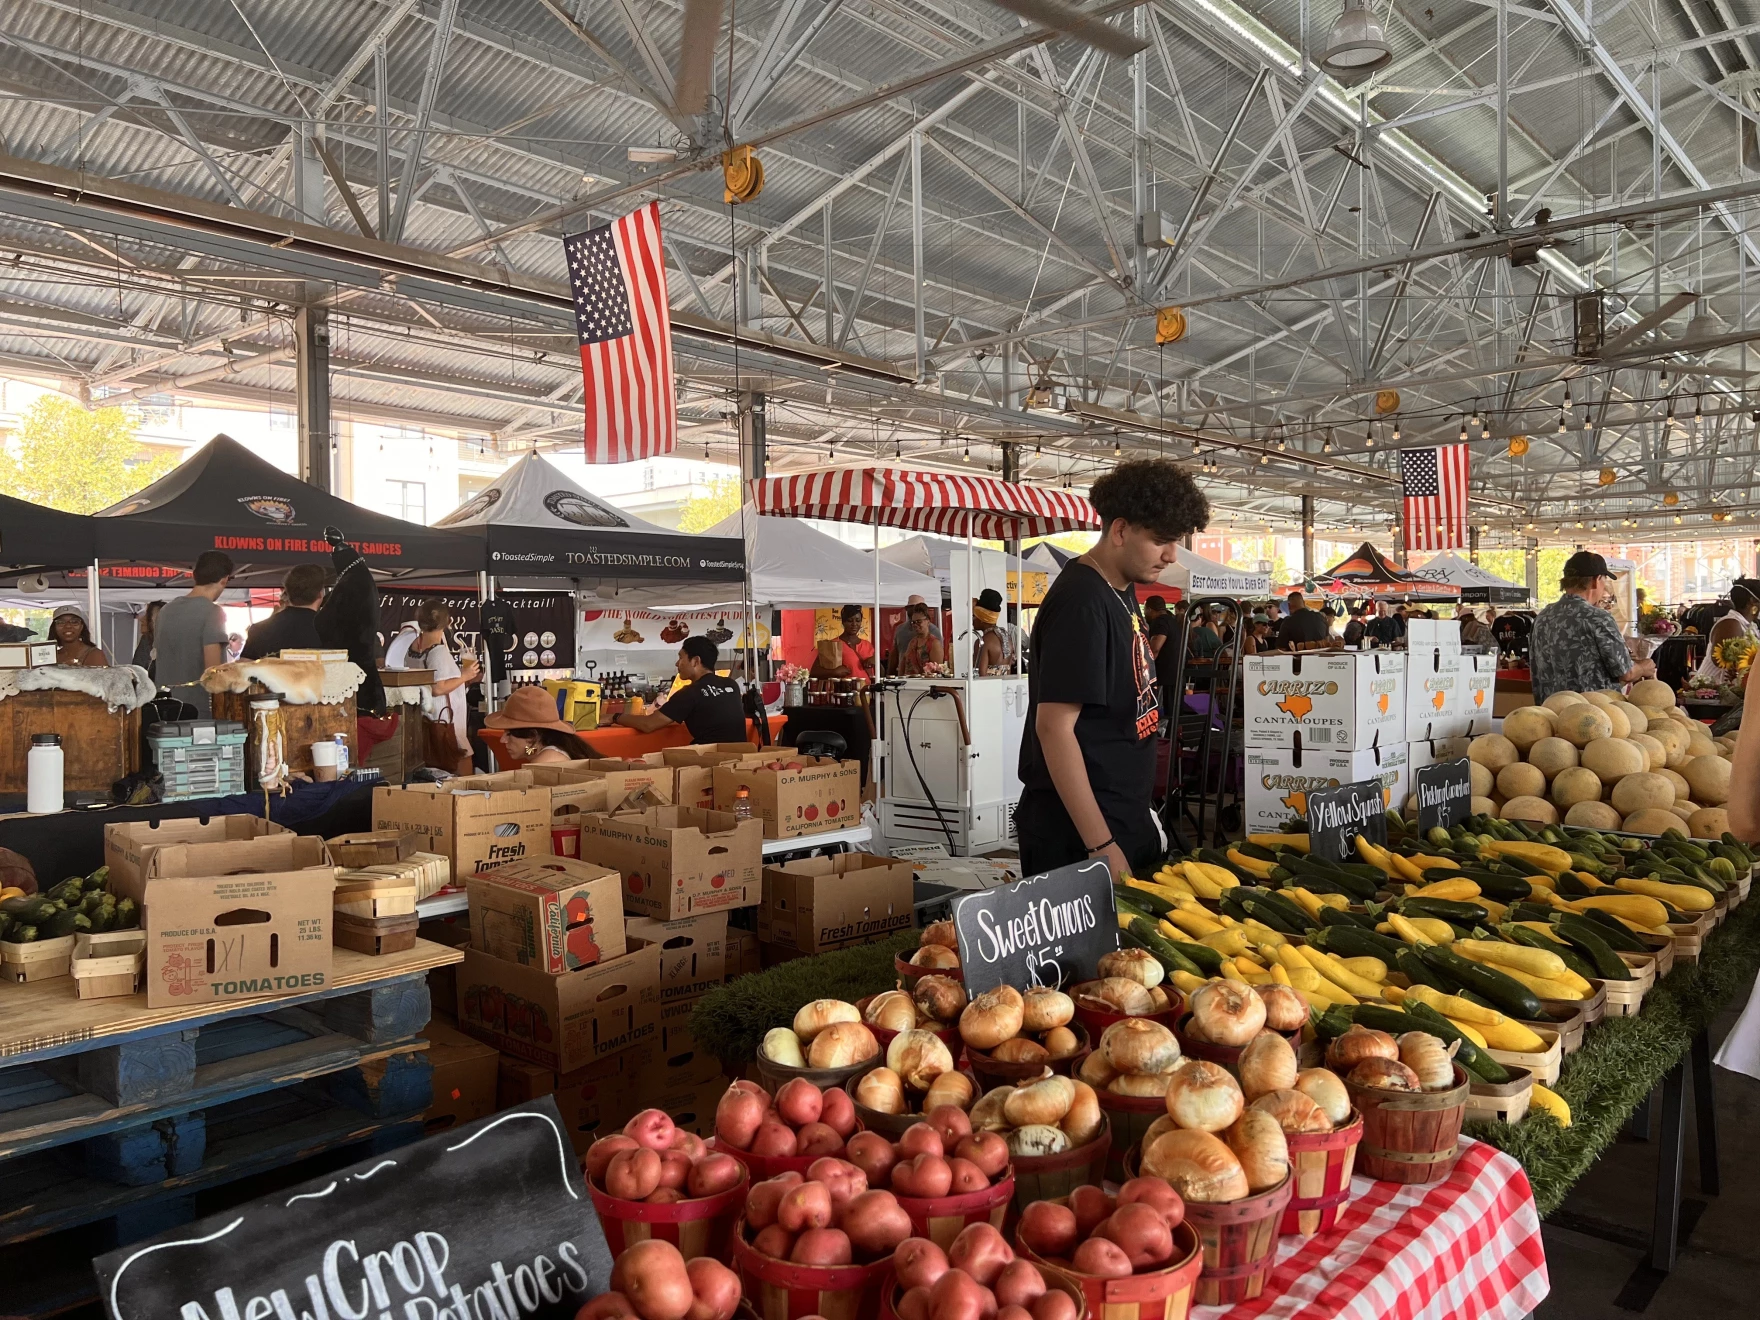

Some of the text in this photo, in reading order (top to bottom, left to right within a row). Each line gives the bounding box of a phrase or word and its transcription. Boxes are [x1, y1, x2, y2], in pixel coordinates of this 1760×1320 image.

[237, 495, 262, 503] KLOWNS
[214, 536, 402, 555] KLOWNS ON FIRE GOUT SAUCES
[501, 552, 555, 562] ToastedSimple
[566, 552, 691, 568] TOASTEDSIMPLE.COM
[1192, 575, 1206, 589] BEST
[1206, 576, 1227, 589] COOKIES
[1228, 577, 1244, 590] YOU'LL
[1245, 578, 1257, 590] EVER
[402, 596, 425, 607] You
[602, 609, 623, 619] THE
[1257, 680, 1339, 697] CARRIZO
[1254, 716, 1343, 726] CANTALOUPES
[781, 777, 797, 785] O.P.
[799, 773, 831, 783] MURPHY
[840, 769, 858, 777] SONS
[1314, 792, 1384, 832] Yellow Squash
[786, 815, 854, 832] CALIFORNIA TOMATOES
[584, 826, 598, 835] O.P.
[600, 828, 633, 841] MURPHY
[644, 837, 668, 848] SONS
[488, 842, 526, 859] Fresh
[626, 894, 663, 910] TOMATOES
[161, 930, 190, 938] PRODUCE
[547, 902, 561, 959] California
[820, 913, 911, 941] Fresh Tomatoes
[977, 894, 1096, 963] Sweet Onions
[668, 955, 689, 980] XLARGE
[210, 972, 325, 996] TOMATOES
[593, 1022, 655, 1056] TOMATOES
[500, 1037, 555, 1068] TOMATOES
[323, 1231, 450, 1320] Crop
[404, 1241, 589, 1320] Potatoes
